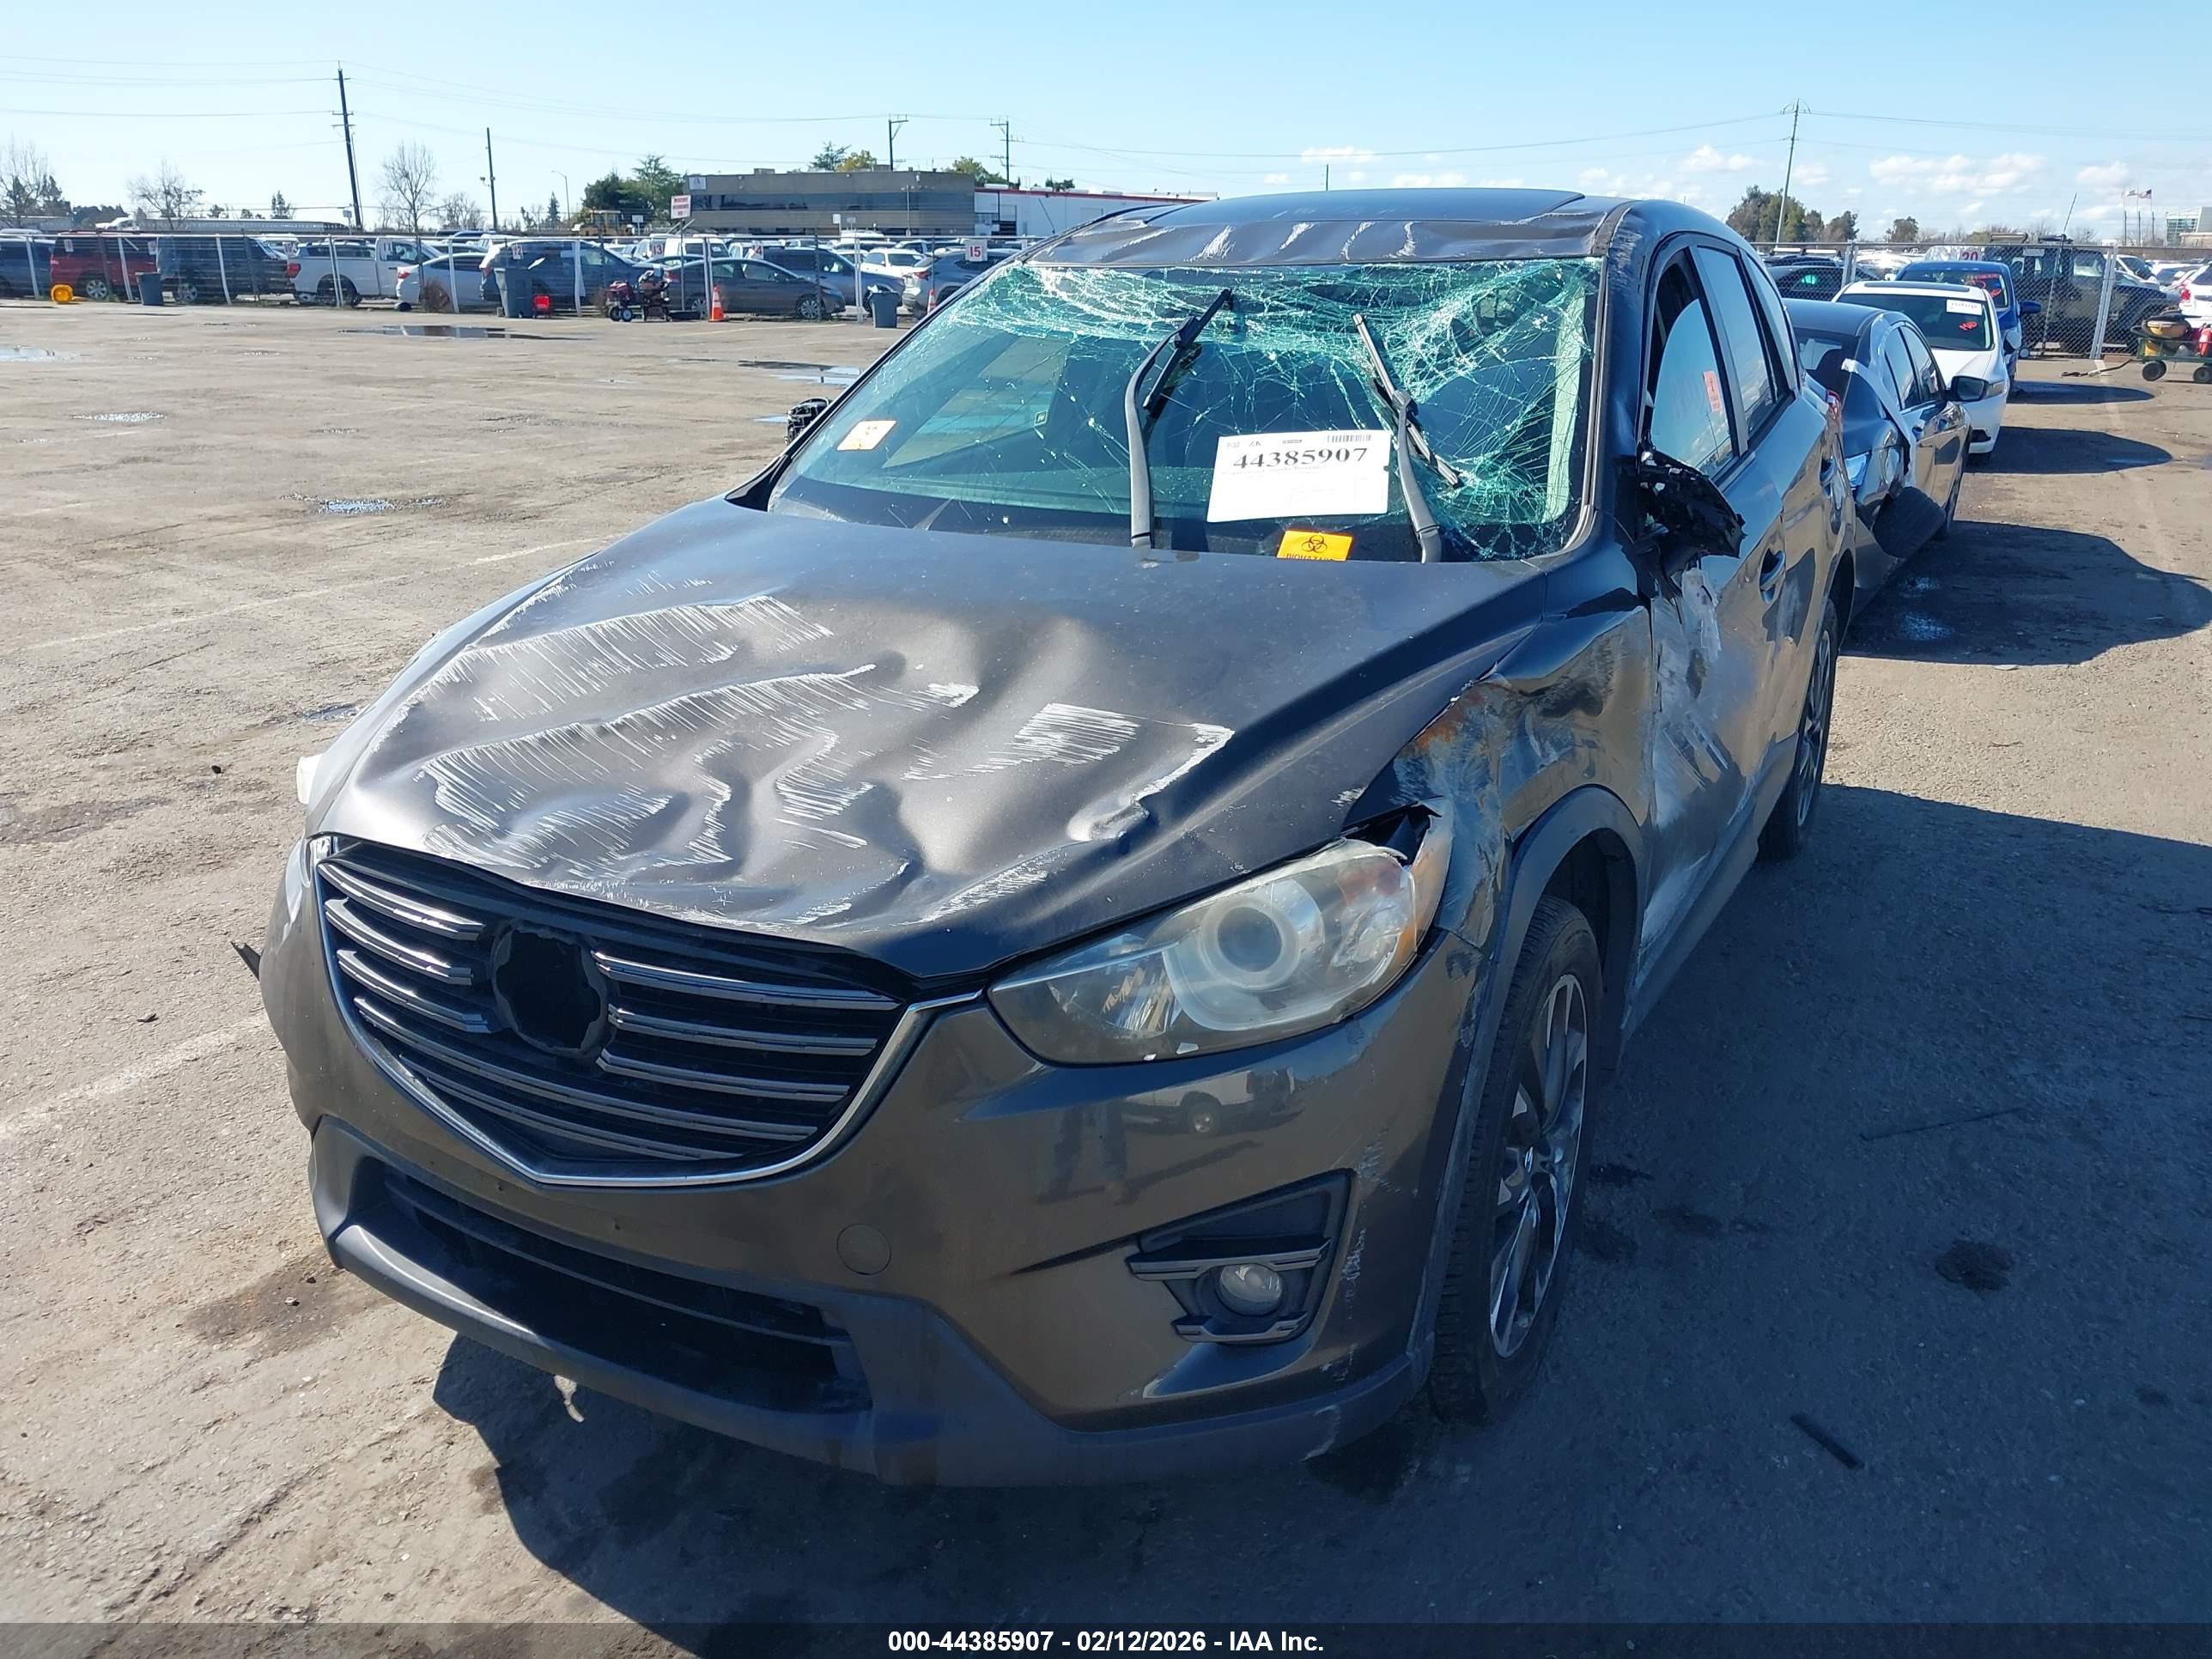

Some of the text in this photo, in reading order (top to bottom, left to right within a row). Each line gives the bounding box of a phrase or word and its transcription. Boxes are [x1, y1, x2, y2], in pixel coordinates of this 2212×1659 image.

[514, 246, 521, 256] 12
[653, 244, 663, 255] 13
[969, 246, 981, 258] 15
[1961, 251, 1978, 260] 20
[1233, 447, 1368, 469] 44385907
[1285, 552, 1334, 561] BIOHA
